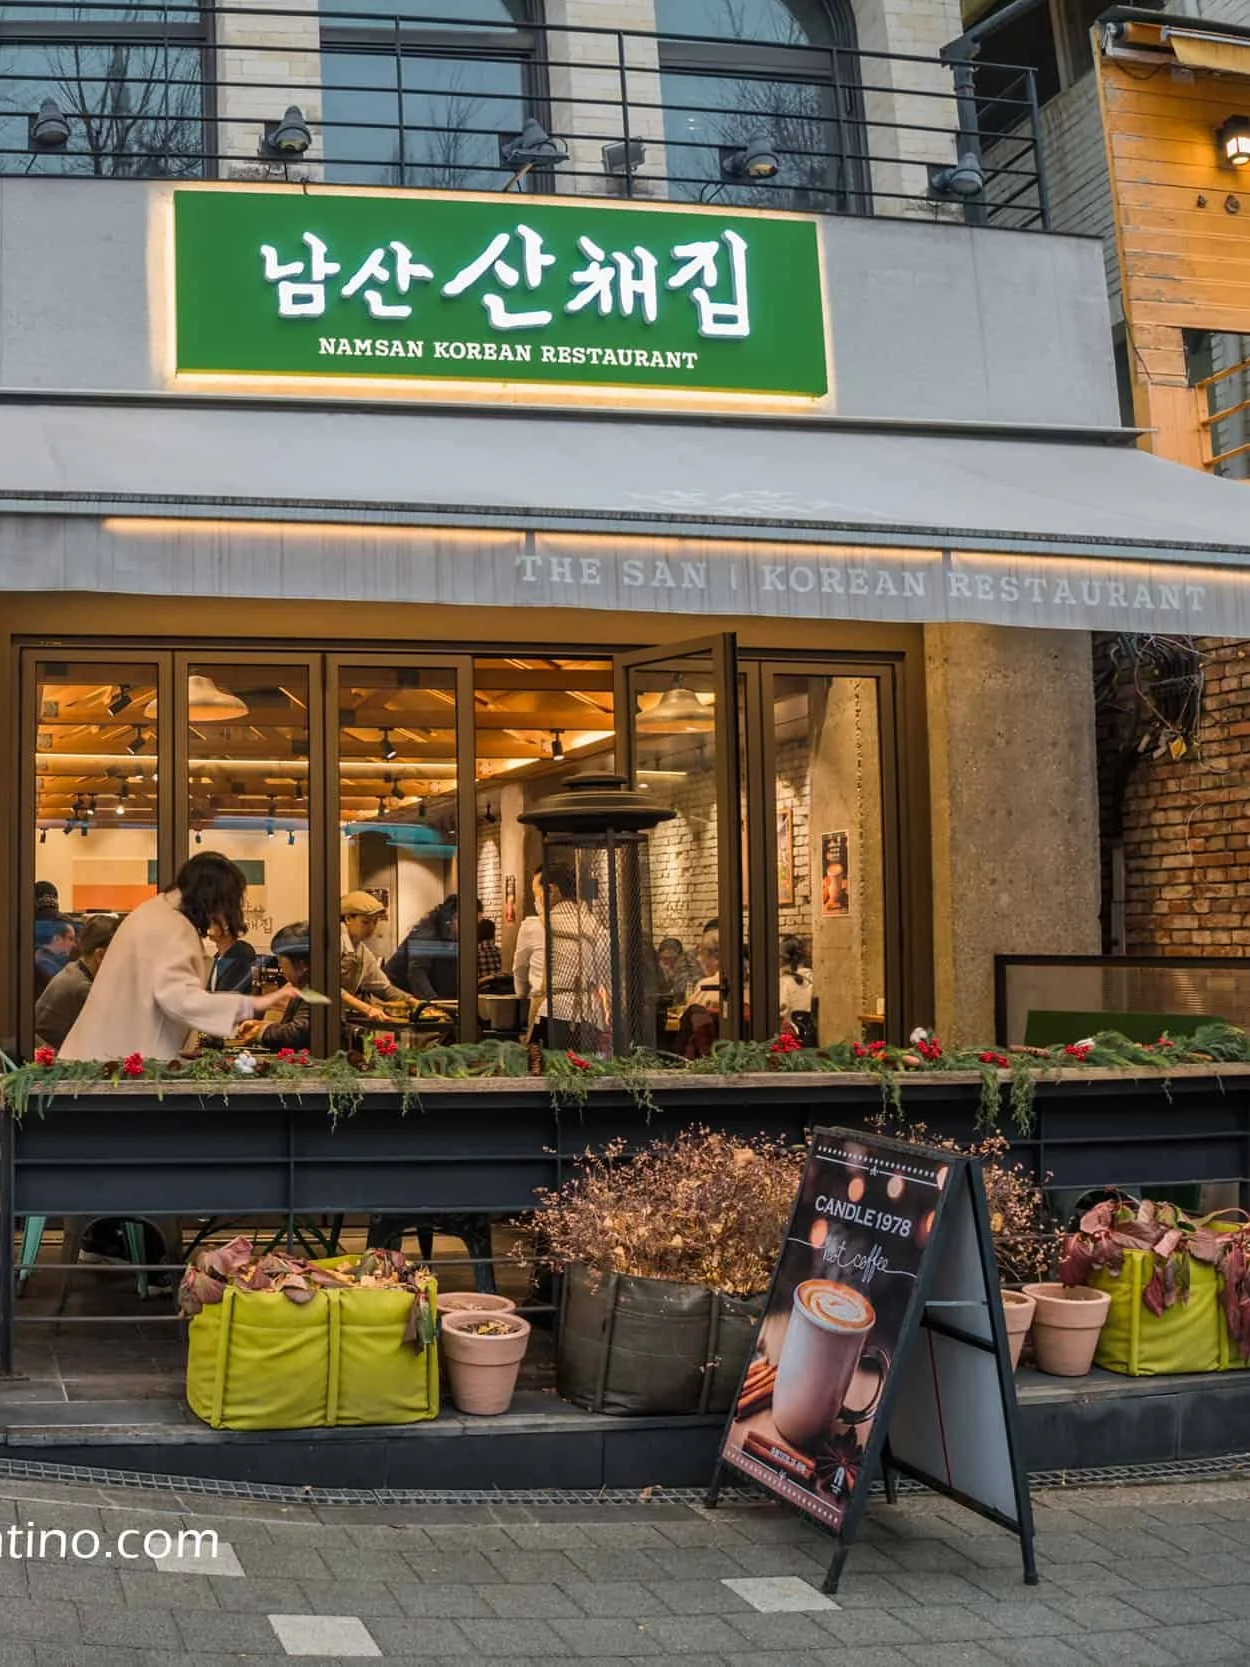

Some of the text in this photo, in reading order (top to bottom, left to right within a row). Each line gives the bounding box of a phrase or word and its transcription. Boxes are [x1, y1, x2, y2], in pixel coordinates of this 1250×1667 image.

[318, 337, 699, 370] NAMSAN KOREAN RESTAURANT
[516, 554, 1207, 613] THE SAN KOREAN RESTAURANT
[853, 1243, 889, 1284] coffee
